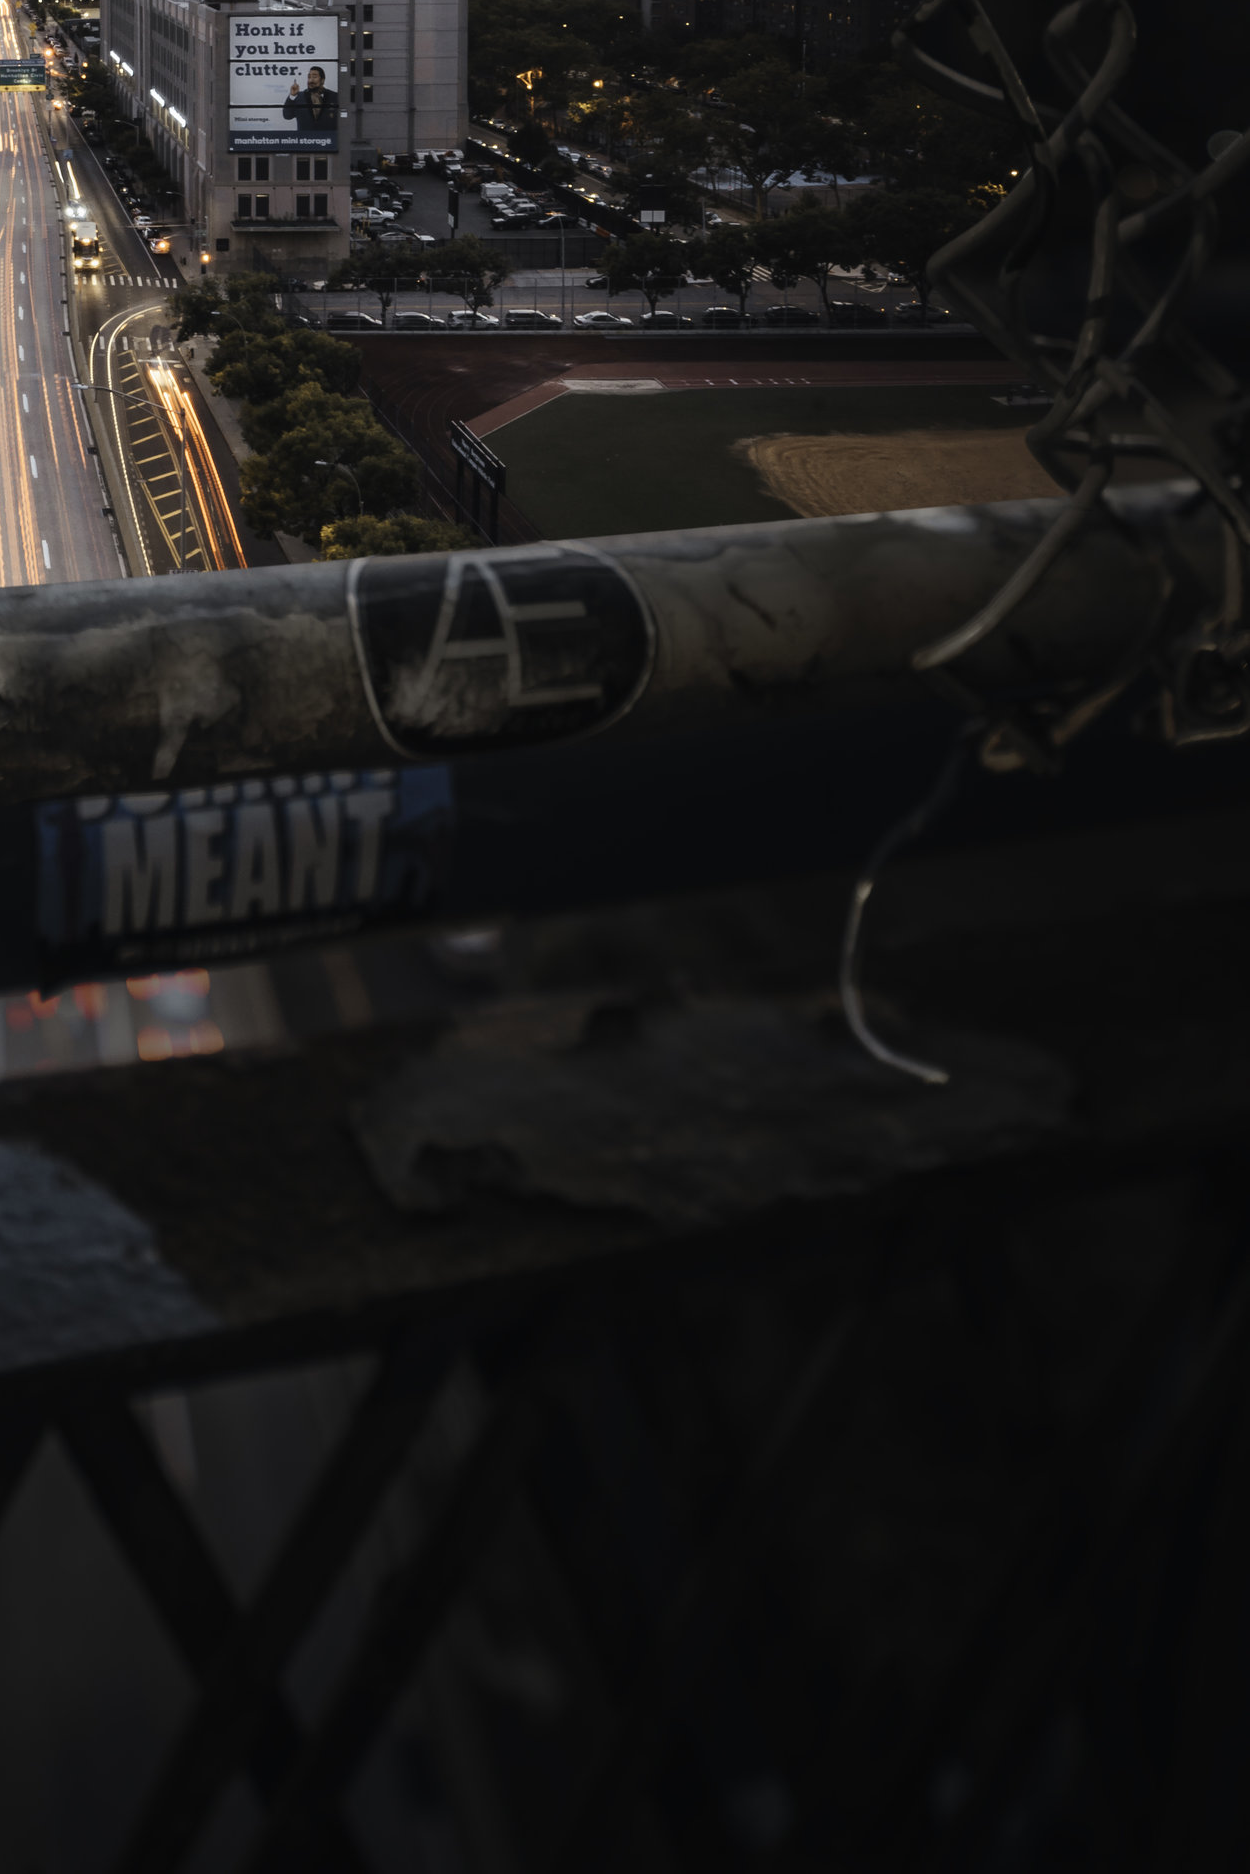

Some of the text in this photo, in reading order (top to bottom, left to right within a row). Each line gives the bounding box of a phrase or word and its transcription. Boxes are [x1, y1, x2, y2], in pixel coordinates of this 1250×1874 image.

[235, 23, 304, 37] Honk if
[235, 42, 316, 58] you hate
[235, 64, 302, 76] clutter.
[234, 135, 331, 146] manhattan mini storage
[101, 790, 396, 938] MEANT
